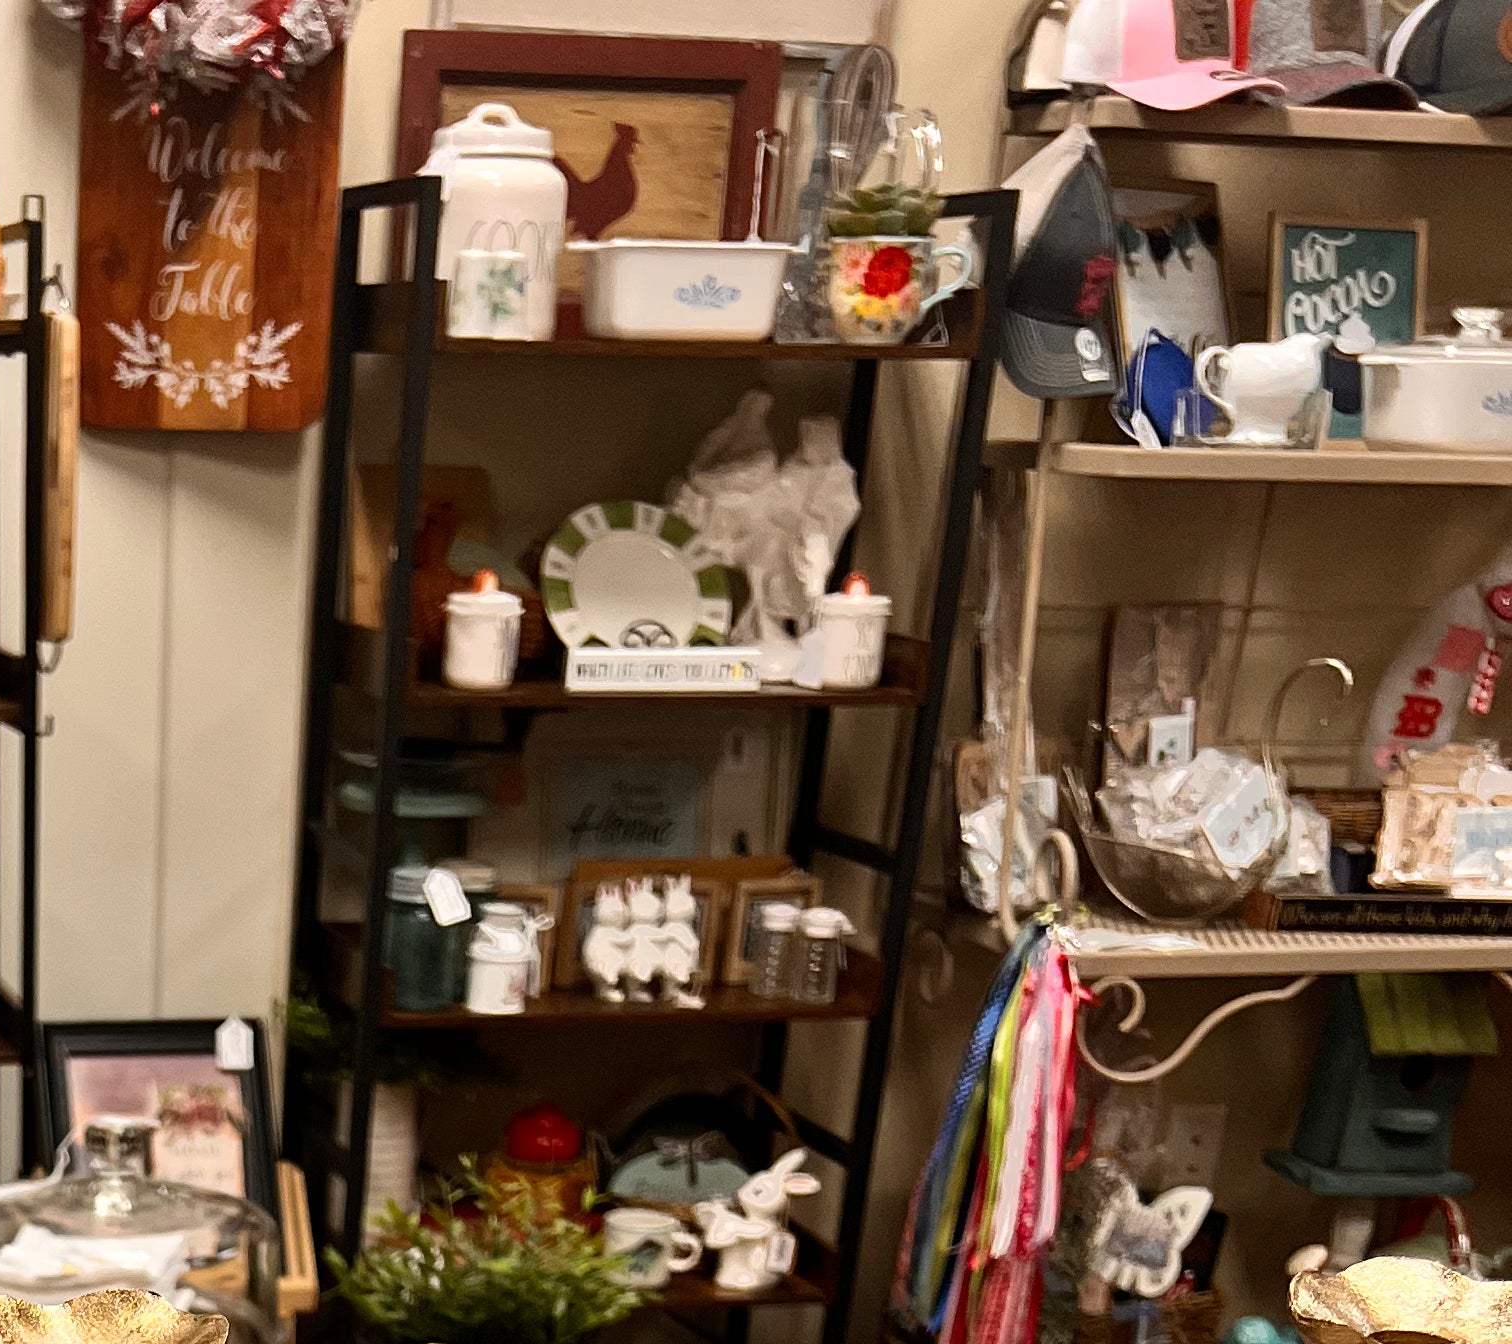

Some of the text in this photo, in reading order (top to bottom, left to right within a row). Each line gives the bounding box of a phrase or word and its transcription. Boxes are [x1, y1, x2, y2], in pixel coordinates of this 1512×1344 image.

[148, 116, 286, 183] Welcome
[158, 186, 257, 253] to the
[149, 258, 255, 322] Table
[1289, 231, 1357, 284] HOT
